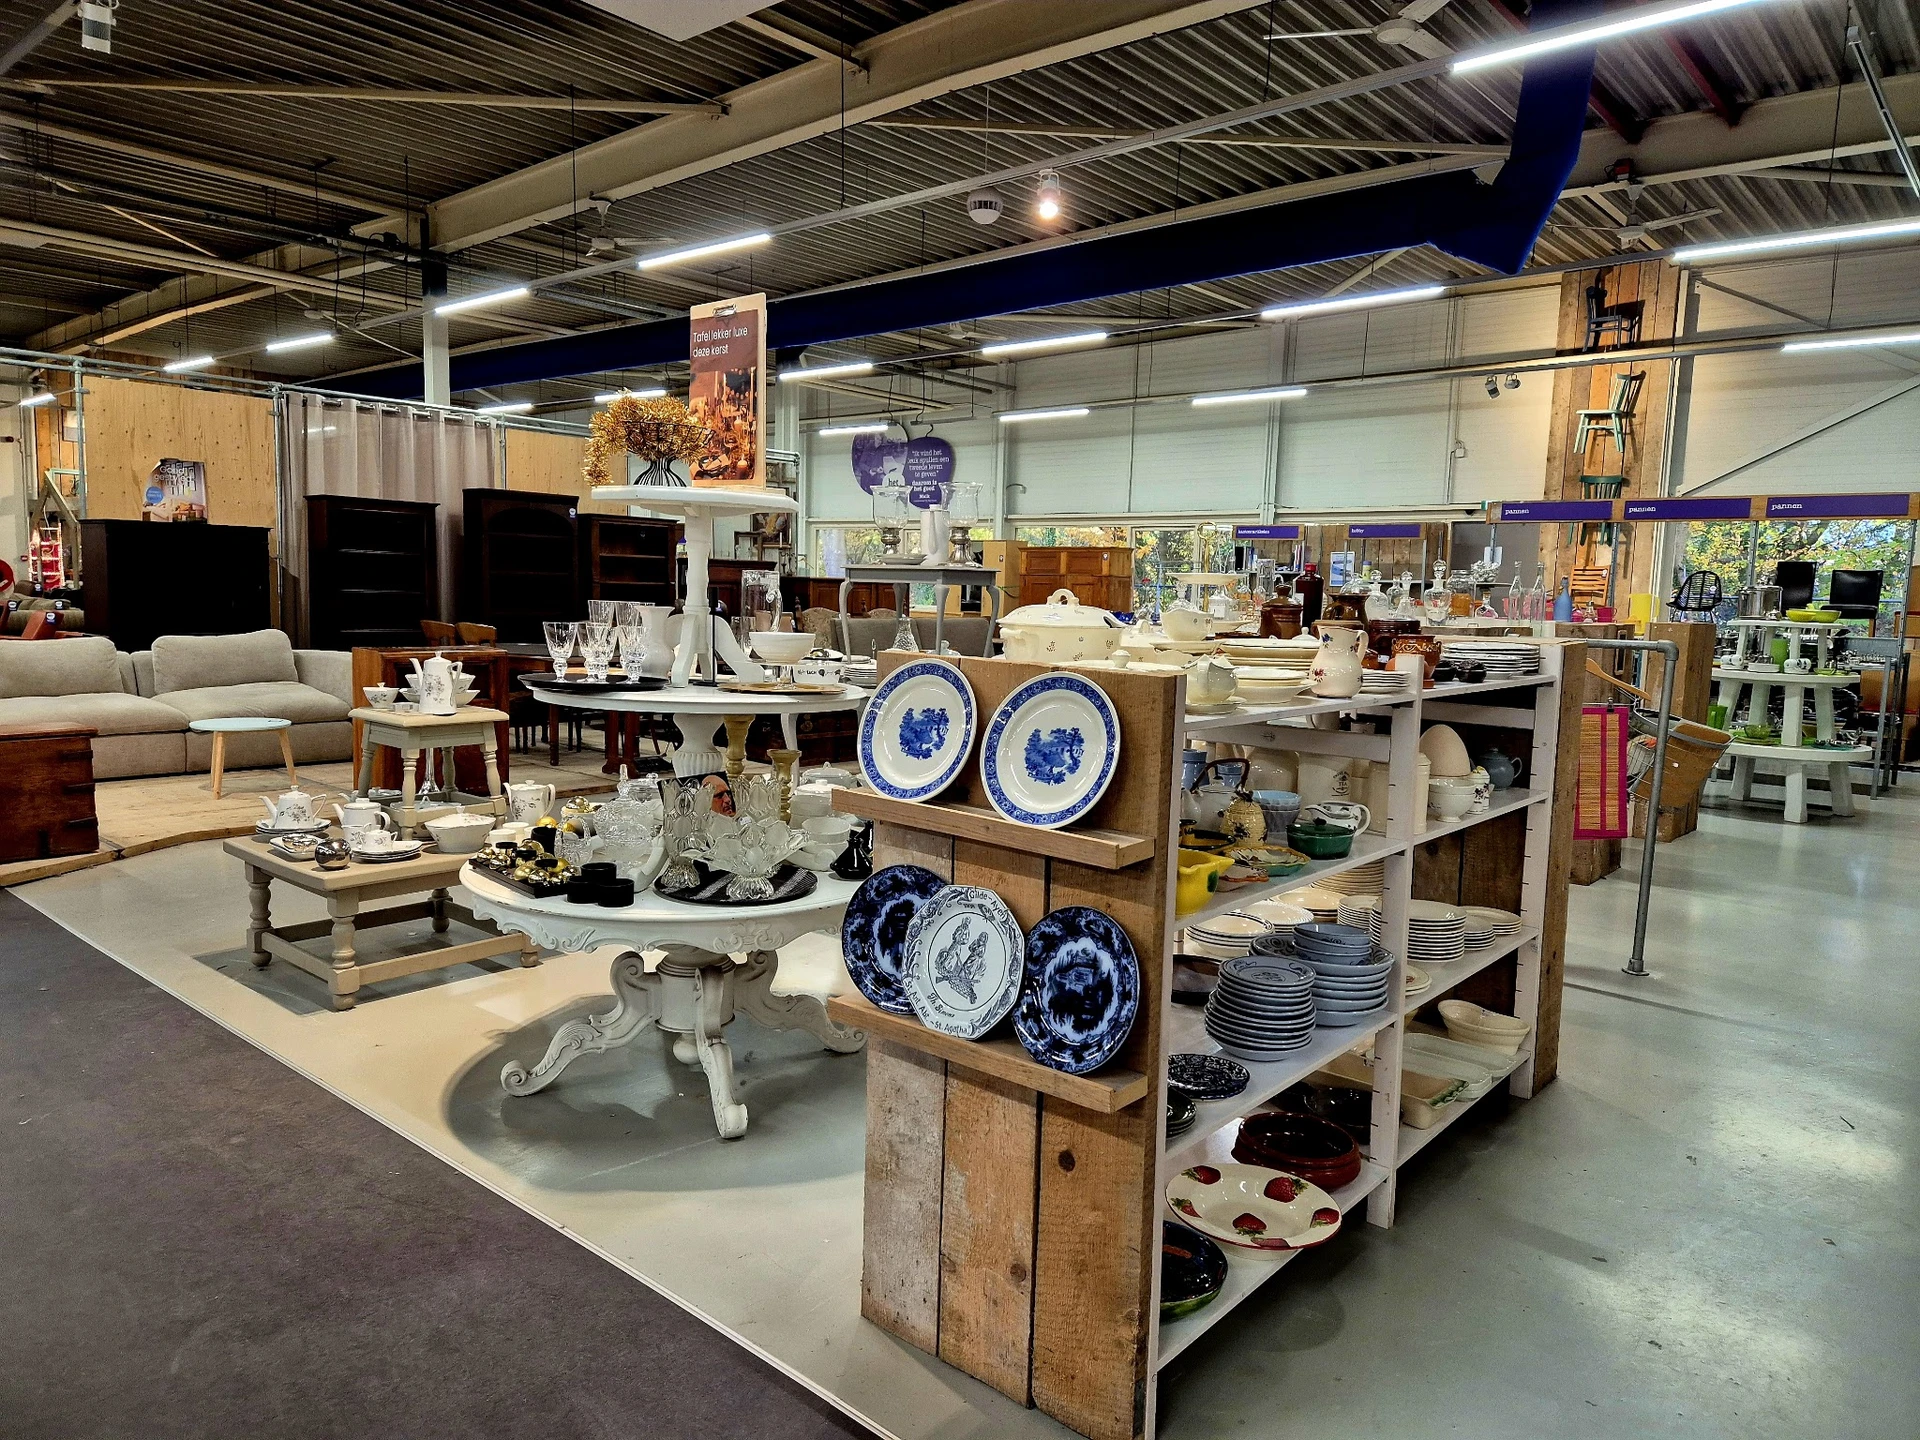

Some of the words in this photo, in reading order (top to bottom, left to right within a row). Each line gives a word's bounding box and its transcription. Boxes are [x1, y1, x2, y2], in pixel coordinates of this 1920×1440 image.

[693, 331, 710, 342] Tafel
[711, 328, 731, 340] lekker
[733, 326, 748, 337] luxe
[693, 347, 710, 357] deze
[711, 344, 729, 355] kerst
[1772, 502, 1802, 510] pannen
